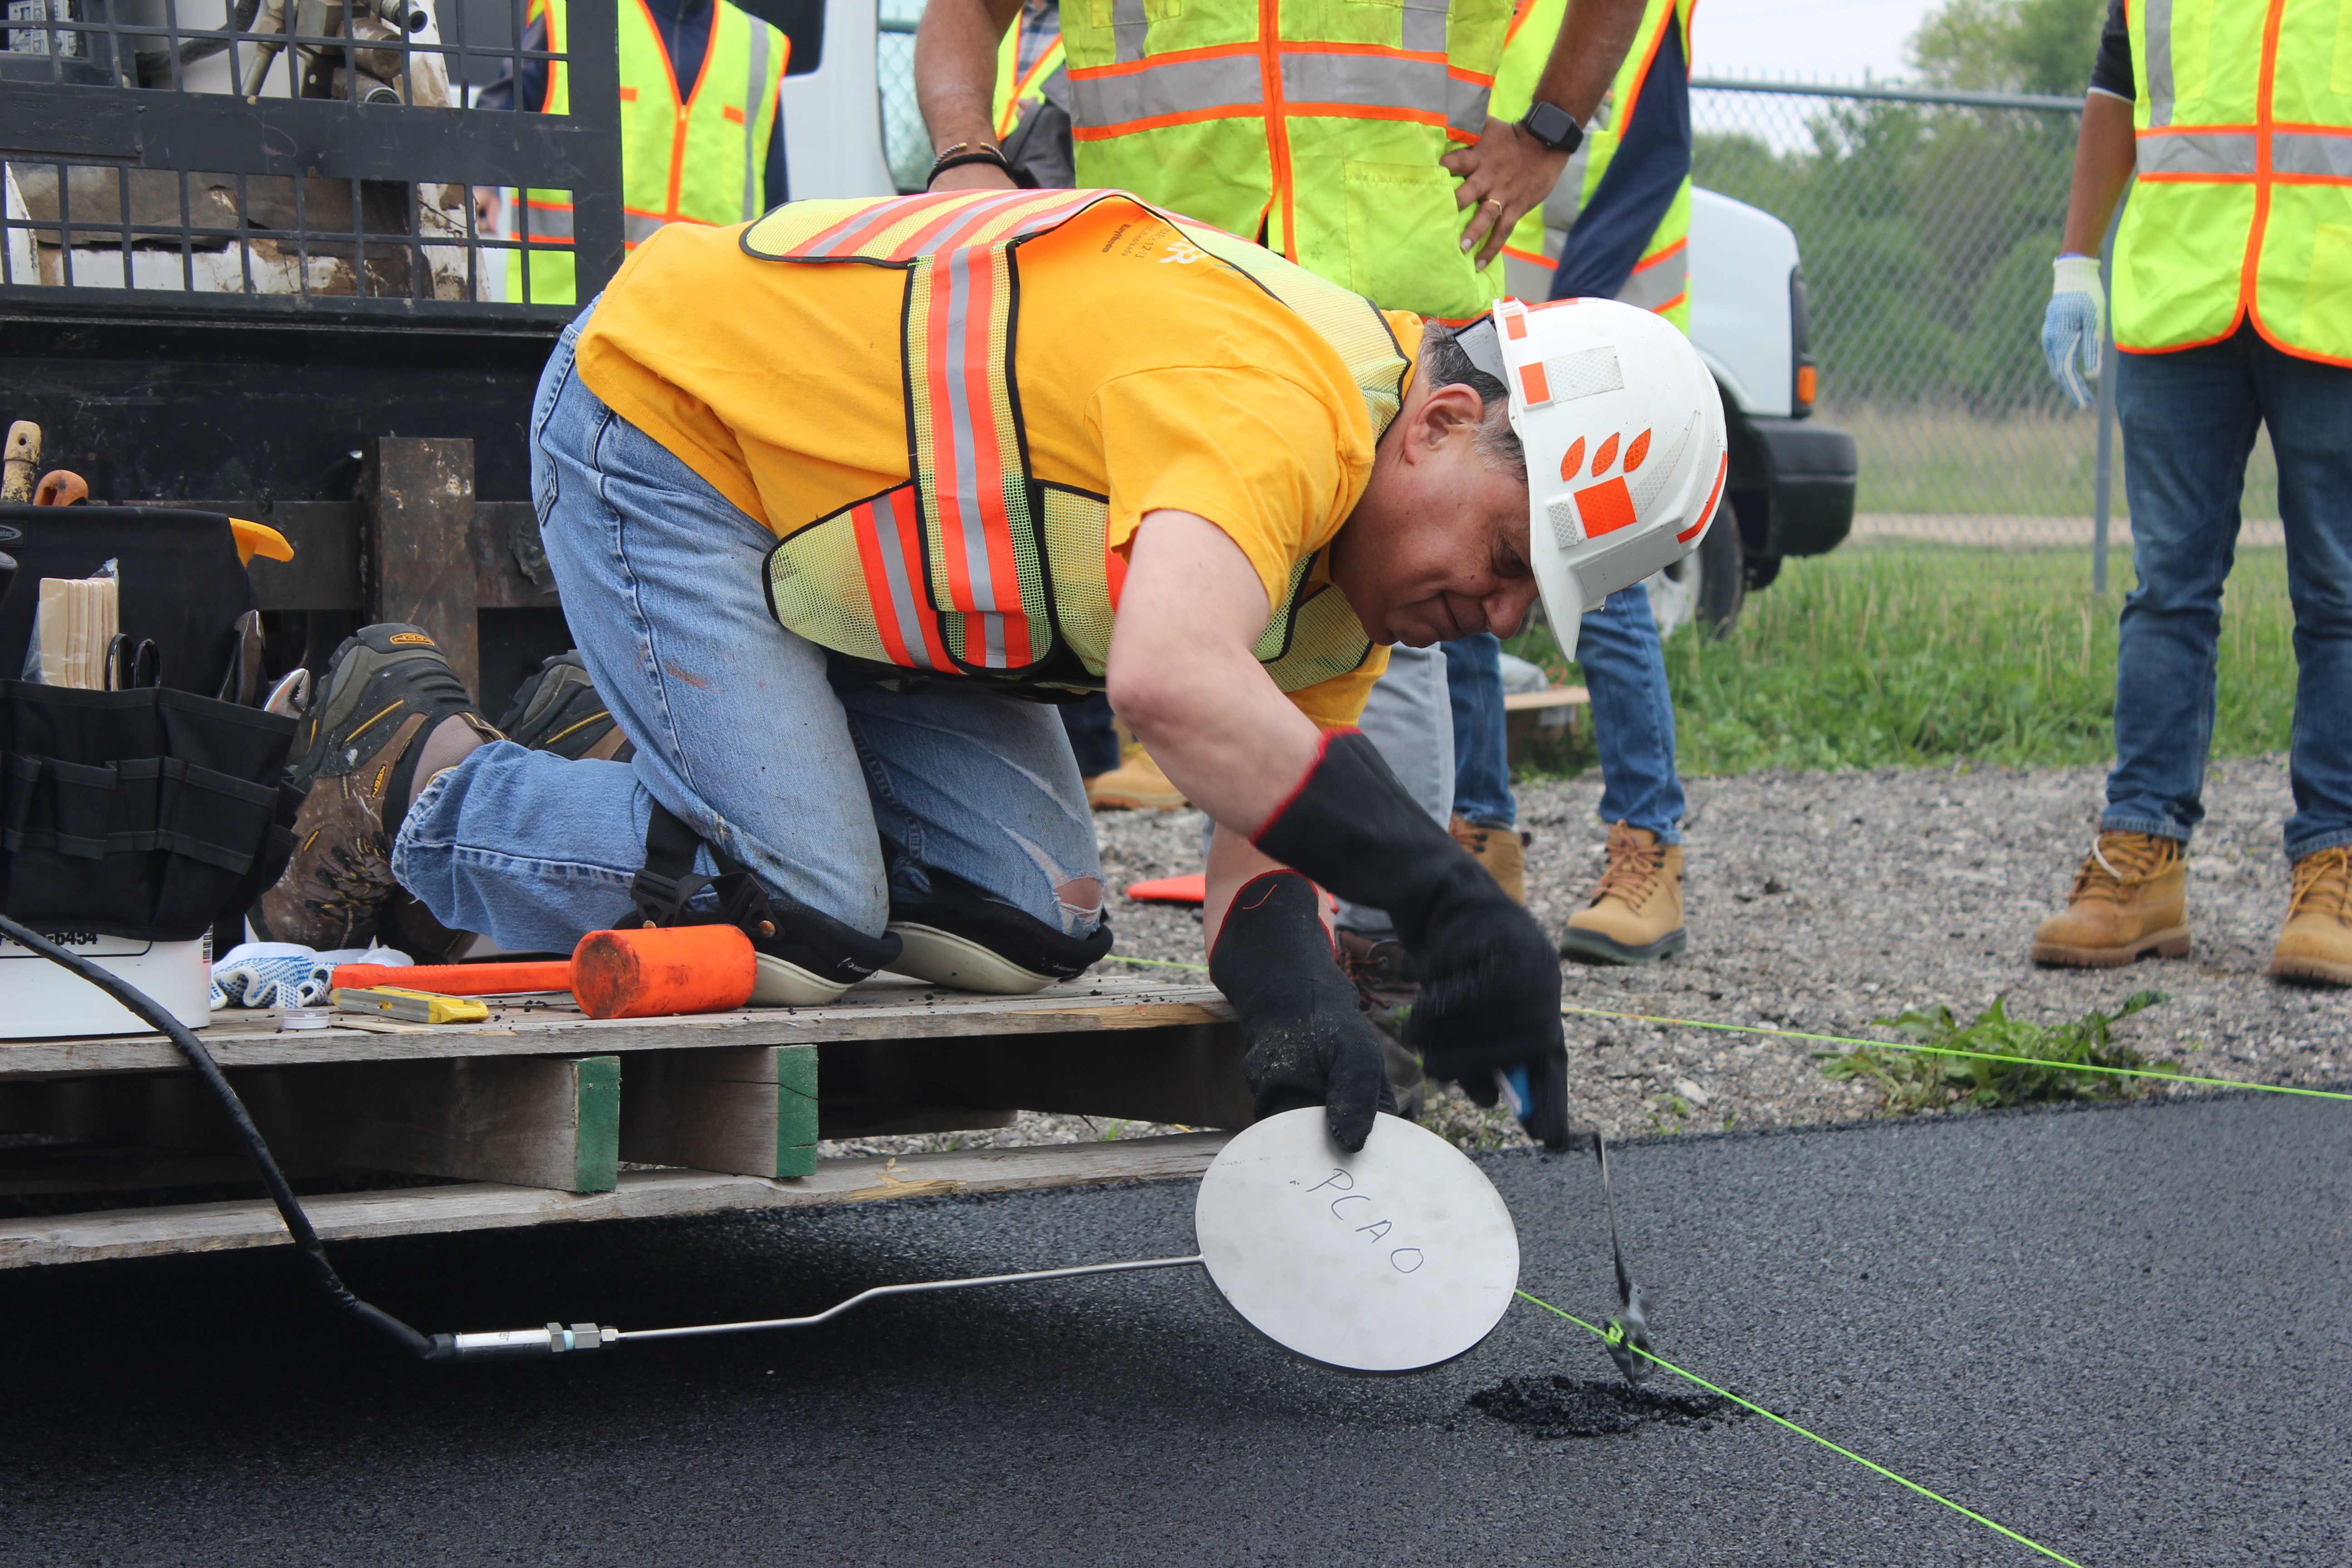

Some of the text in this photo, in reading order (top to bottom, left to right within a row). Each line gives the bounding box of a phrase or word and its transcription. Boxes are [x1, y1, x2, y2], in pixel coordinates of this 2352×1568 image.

[1135, 227, 1172, 258] MARCH 12-13
[372, 766, 386, 798] KEEN
[1306, 1168, 1424, 1273] PCAO
